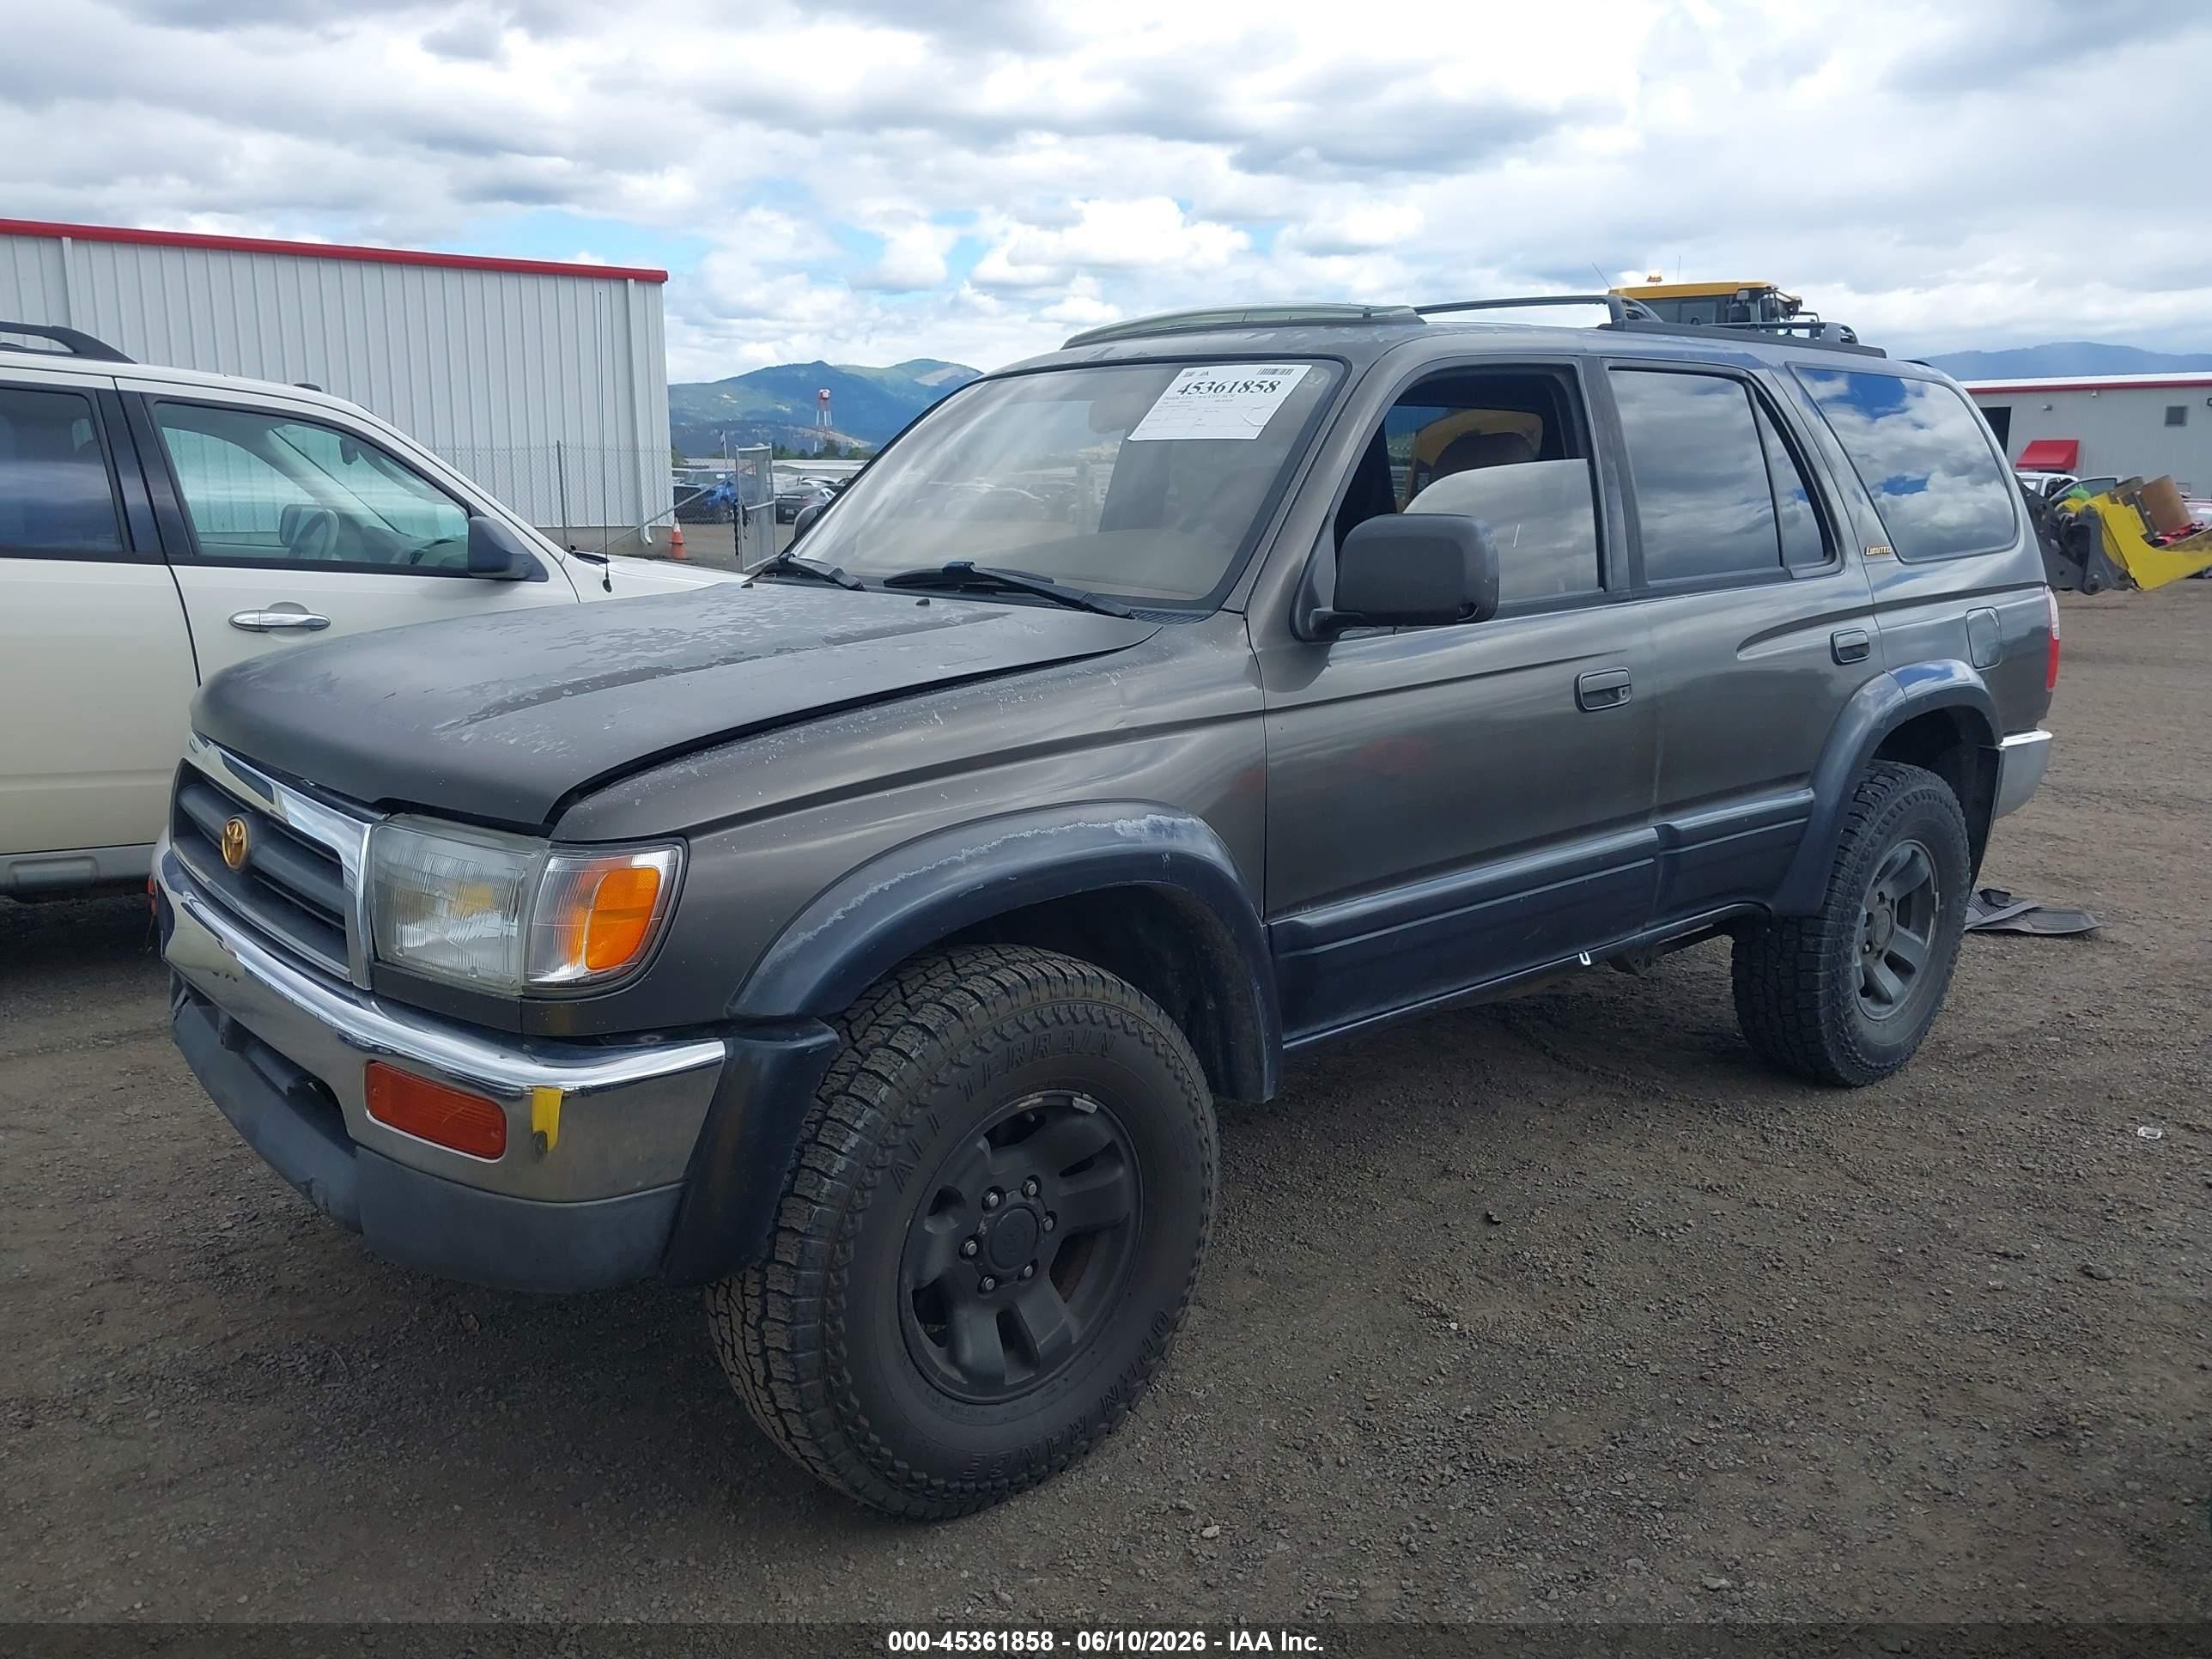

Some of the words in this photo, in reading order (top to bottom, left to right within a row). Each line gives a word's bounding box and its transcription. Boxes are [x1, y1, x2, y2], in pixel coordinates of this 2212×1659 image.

[1177, 380, 1281, 395] 45361858
[890, 1112, 941, 1194] ALL
[957, 1030, 1116, 1103] TERRAIN
